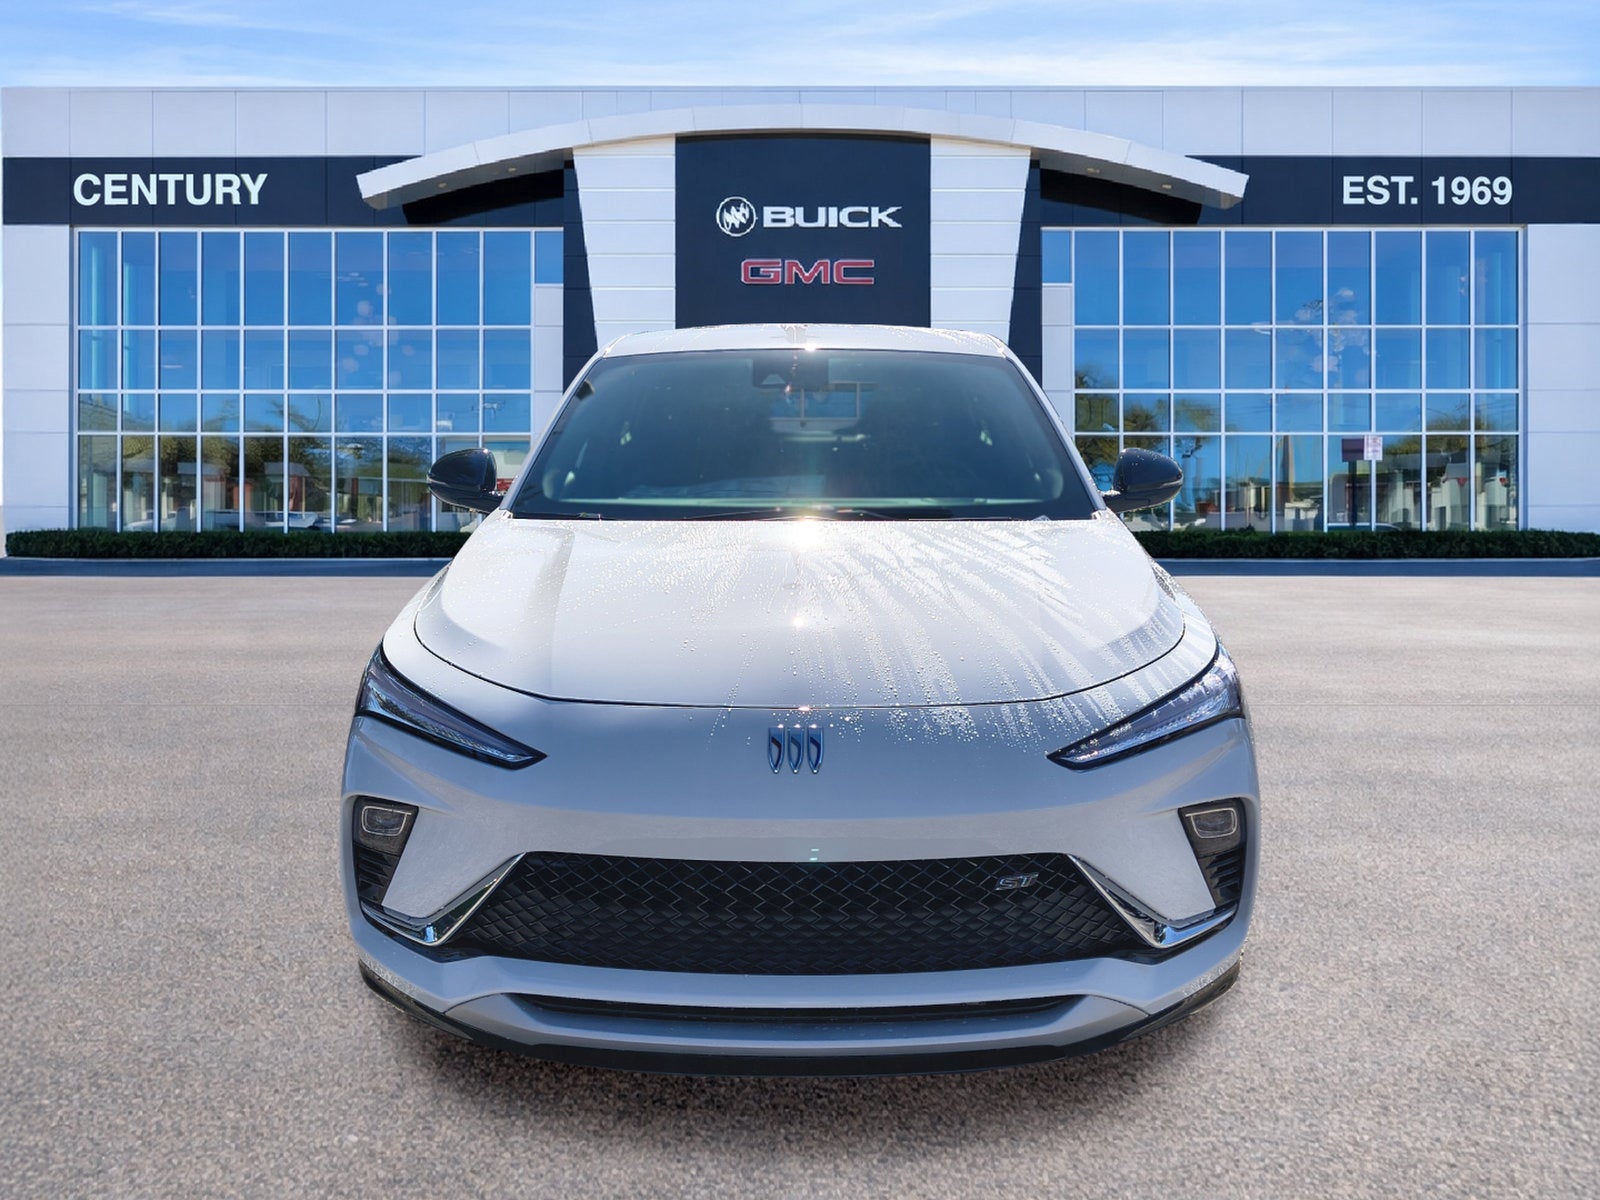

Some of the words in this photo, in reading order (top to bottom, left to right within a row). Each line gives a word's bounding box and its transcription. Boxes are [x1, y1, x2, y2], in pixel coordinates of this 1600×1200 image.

[73, 173, 268, 206] CENTURY
[1342, 175, 1418, 205] EST.
[1431, 175, 1513, 205] 1969
[762, 206, 903, 228] BUICK
[740, 258, 875, 285] GMC
[995, 872, 1039, 891] ST
